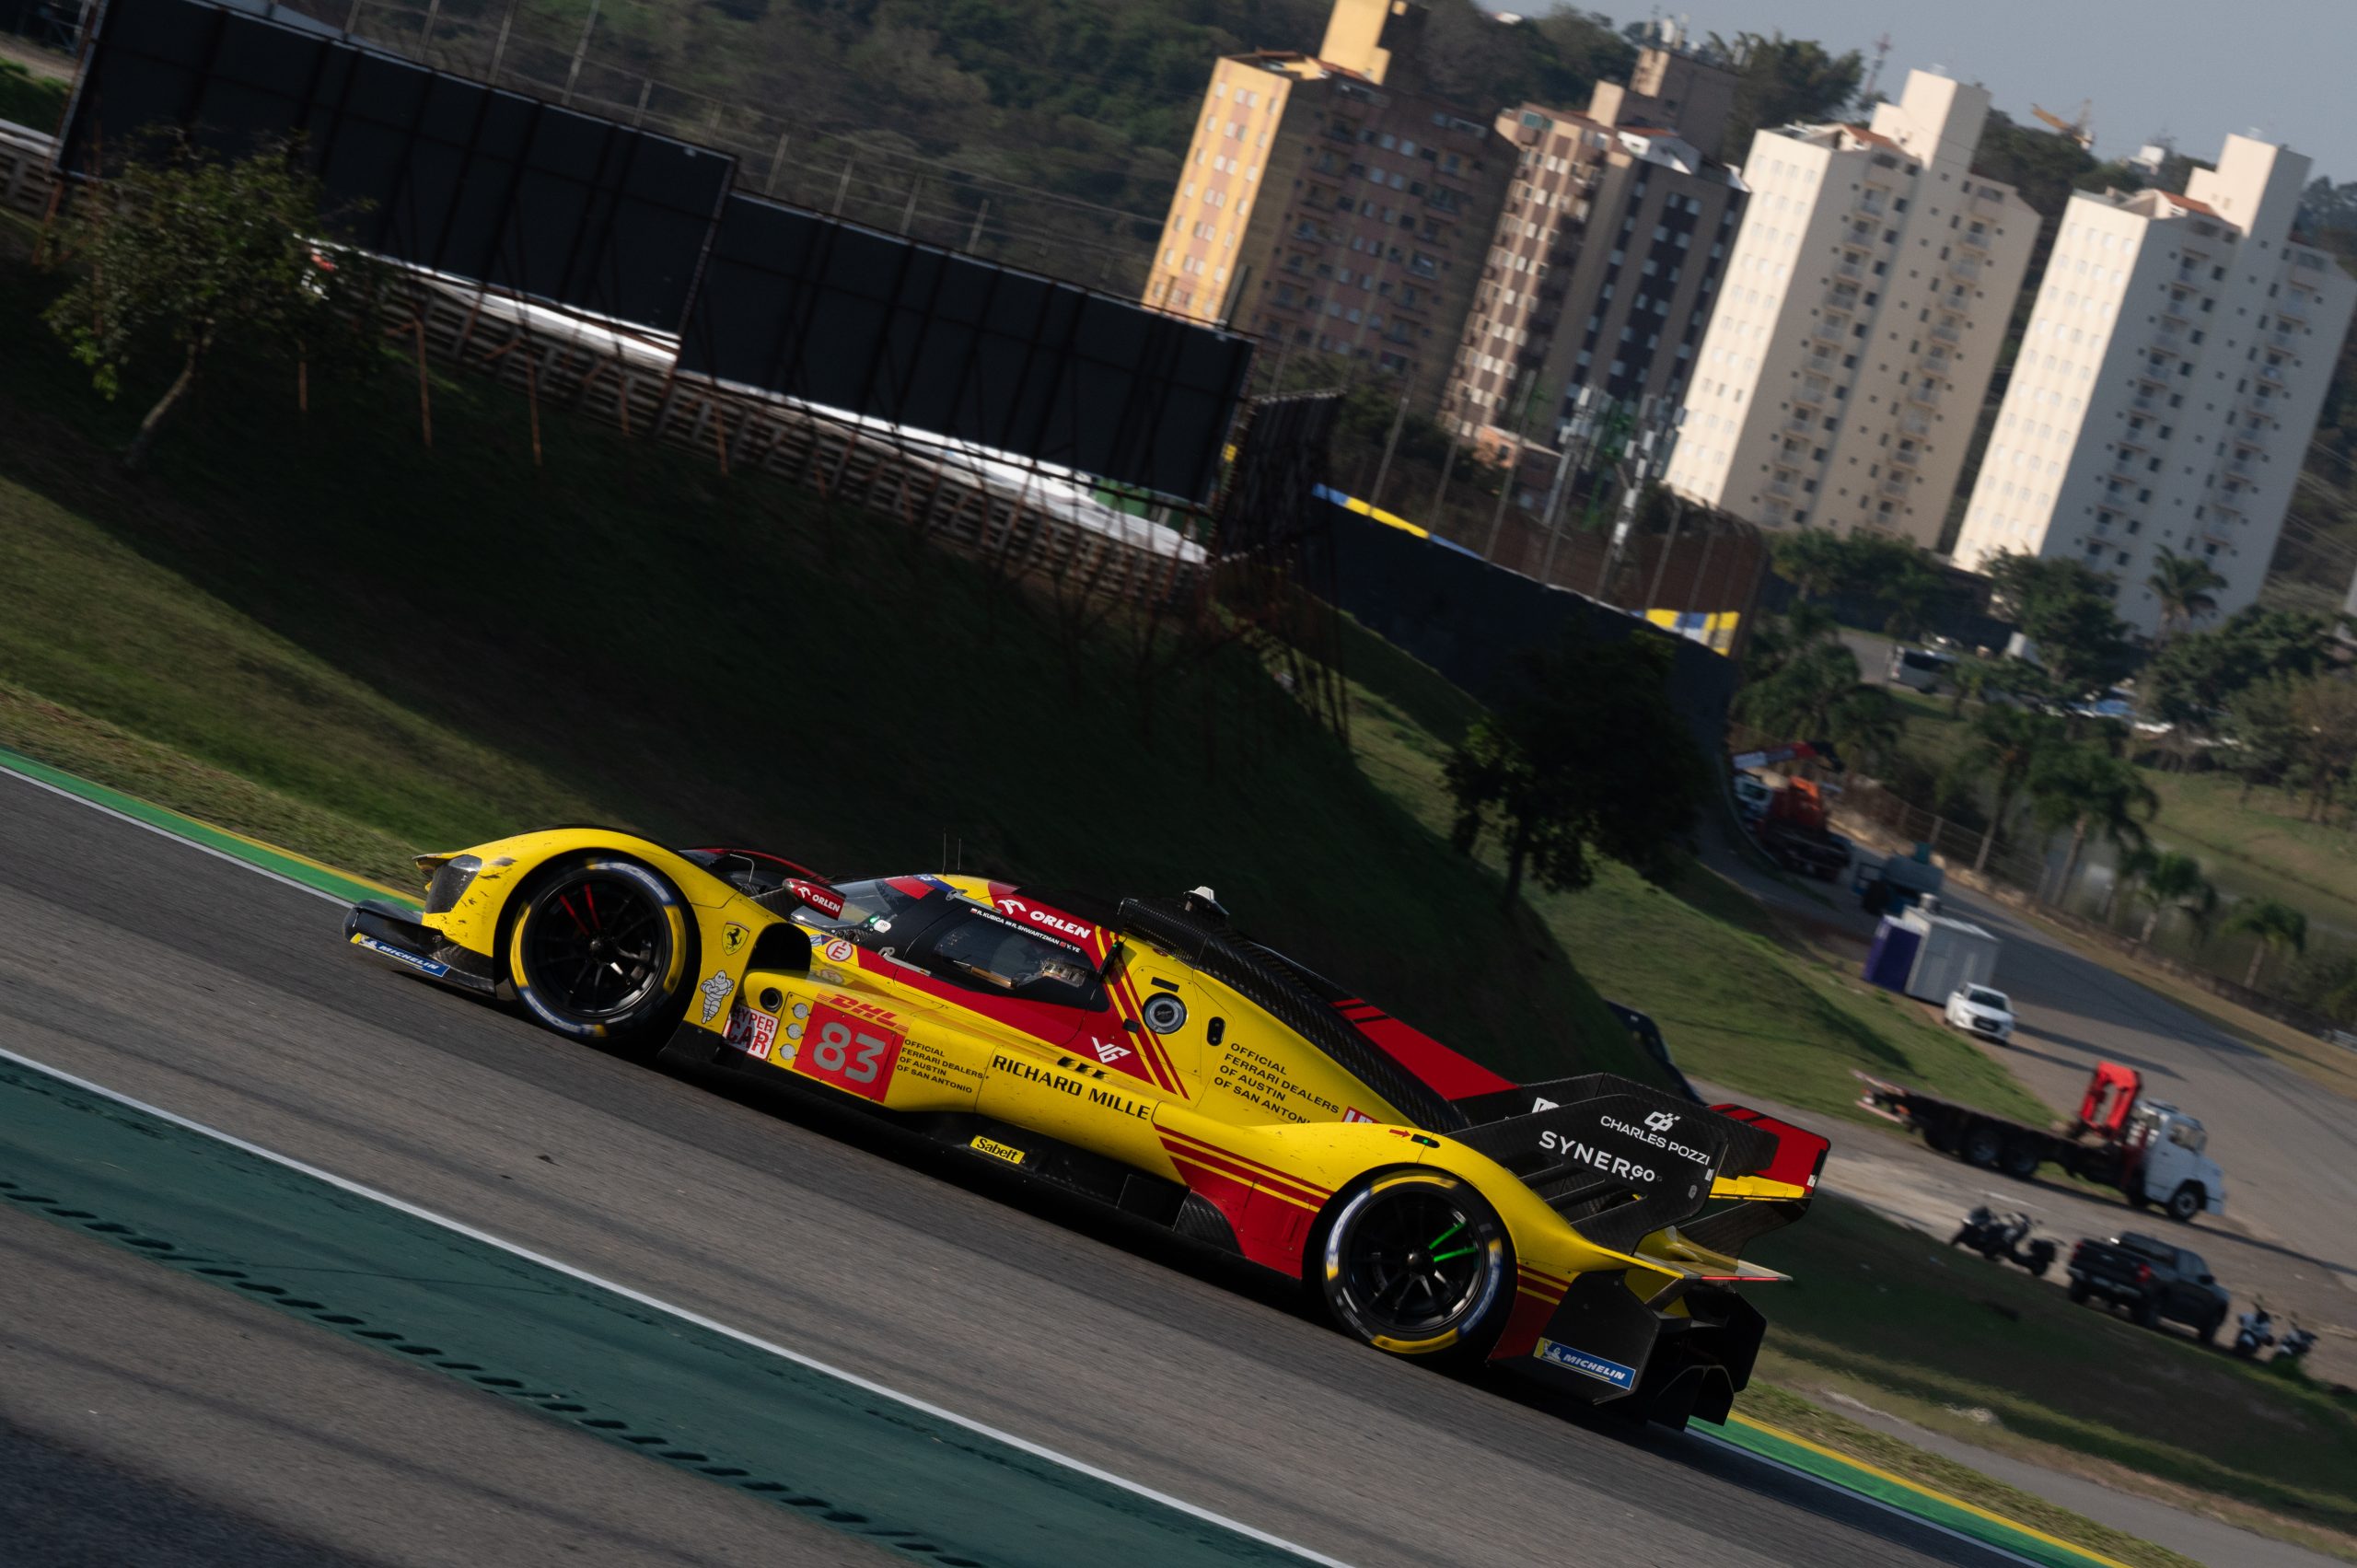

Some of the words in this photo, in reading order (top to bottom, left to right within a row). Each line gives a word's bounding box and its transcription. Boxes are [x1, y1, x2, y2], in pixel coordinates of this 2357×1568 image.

[812, 894, 842, 912] ORLEN
[1029, 911, 1091, 939] ORLEN
[377, 945, 440, 970] MICHELIN
[828, 993, 900, 1028] DHL
[727, 1020, 771, 1055] CAR
[813, 1021, 887, 1084] 83
[904, 1039, 946, 1058] OFFICIAL
[899, 1056, 912, 1064] OF
[912, 1060, 946, 1076] AUSTIN
[900, 1047, 941, 1064] FERRARI
[942, 1061, 984, 1080] DEALERS
[1230, 1042, 1287, 1075] OFFICIAL
[911, 1068, 930, 1080] SAN
[931, 1075, 973, 1094] ANTONIO
[992, 1054, 1084, 1097] RICHARD
[1088, 1087, 1152, 1121] MILLE
[1213, 1076, 1233, 1088] OF
[1233, 1085, 1260, 1104] SAN
[1219, 1064, 1238, 1076] OF
[1237, 1074, 1286, 1101] AUSTIN
[1225, 1052, 1279, 1085] FERRARI
[1281, 1080, 1340, 1114] DEALERS
[976, 1137, 1019, 1162] Sabelt
[1599, 1115, 1667, 1149] CHARLES
[1667, 1140, 1711, 1166] POZZI
[1562, 1353, 1626, 1380] MICHELIN
